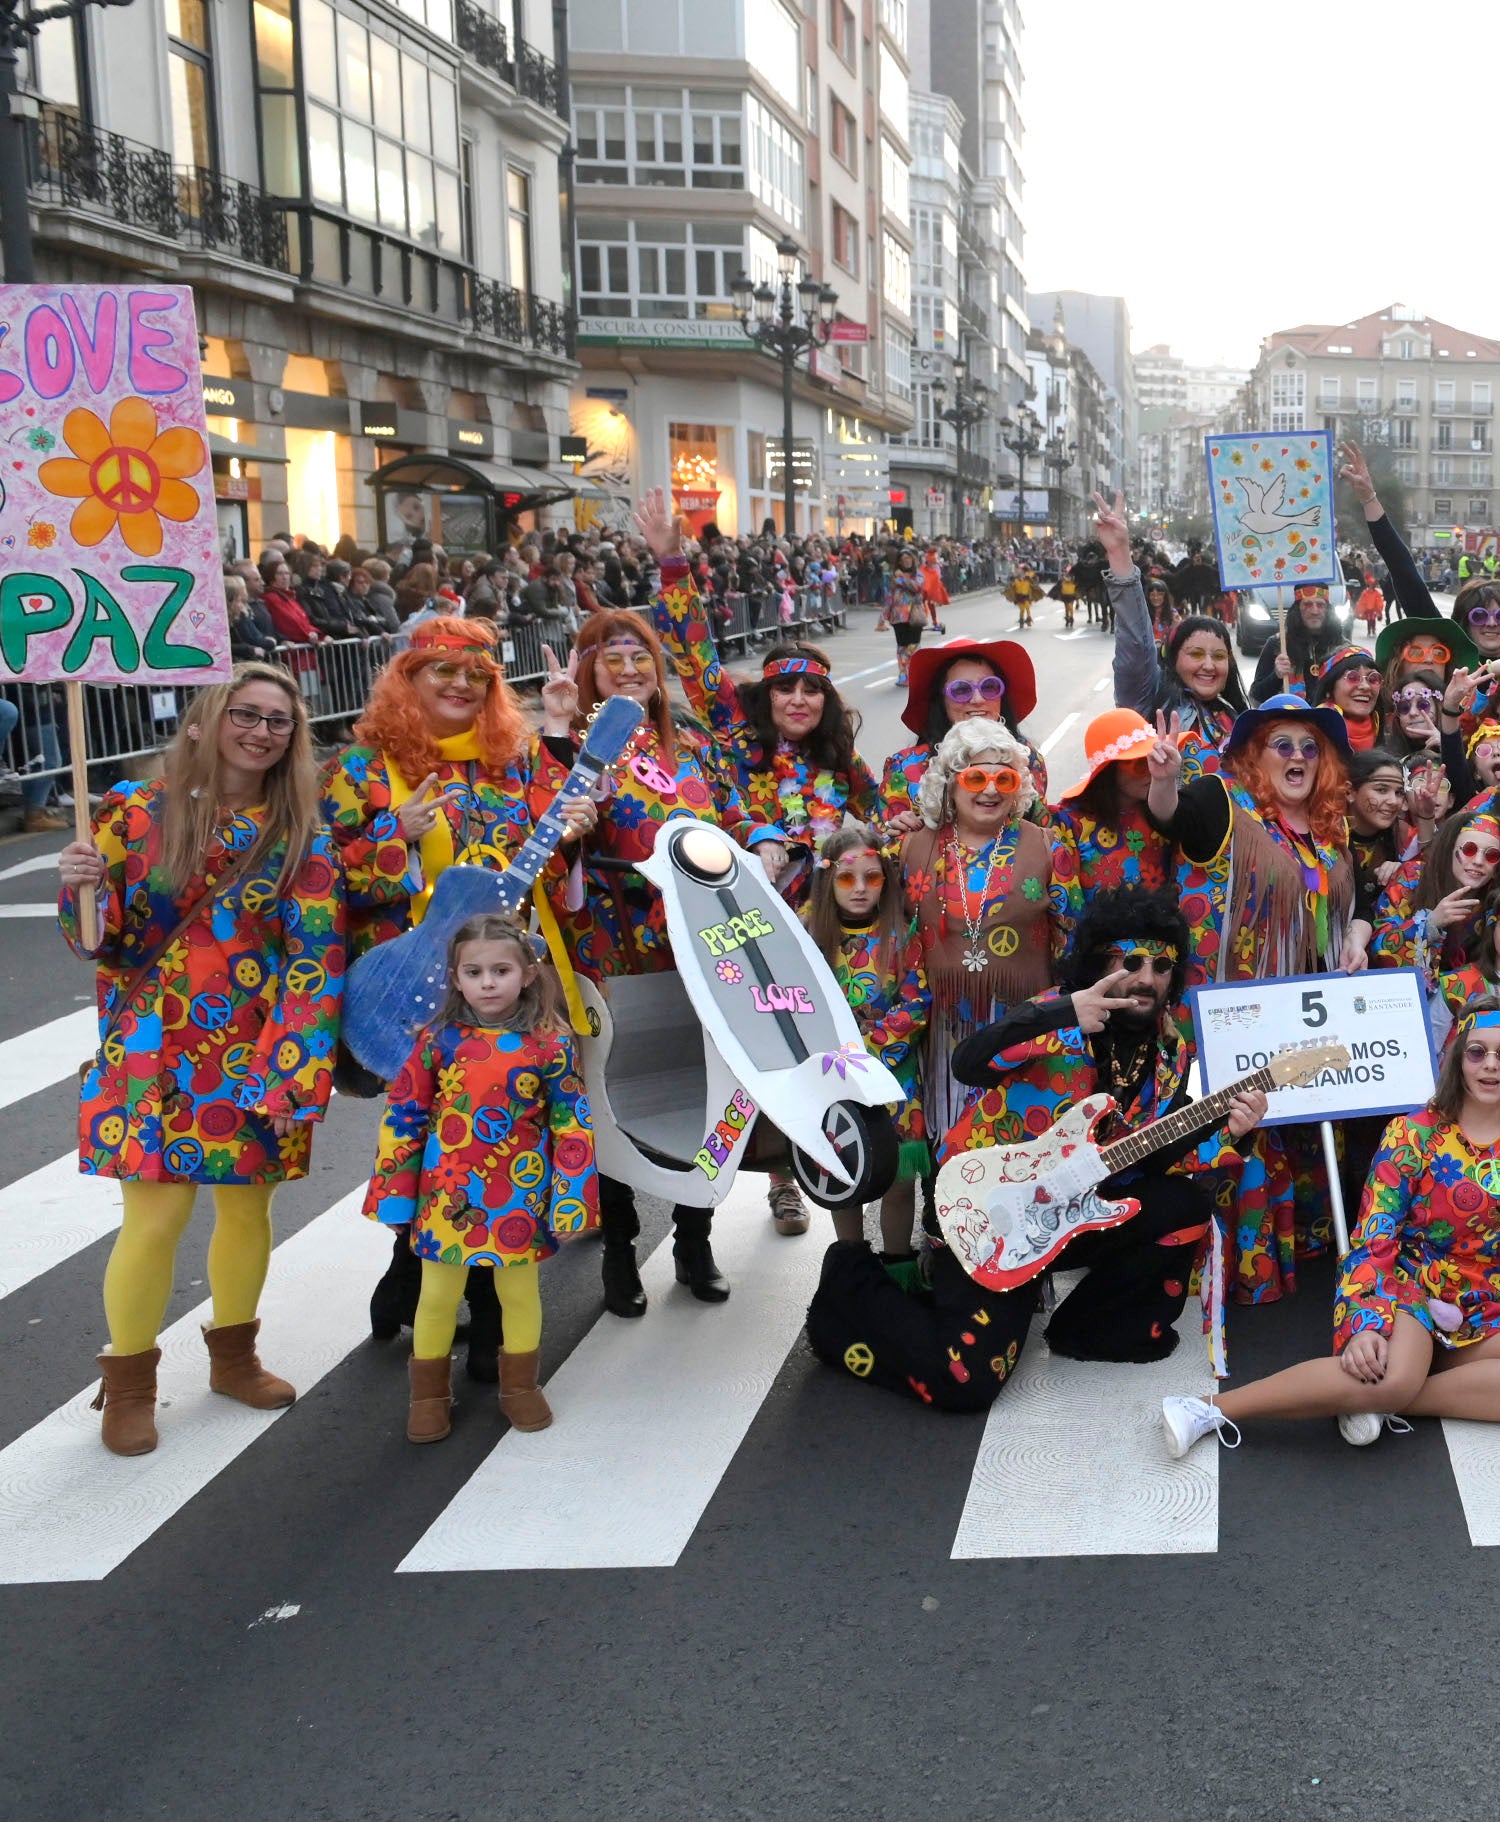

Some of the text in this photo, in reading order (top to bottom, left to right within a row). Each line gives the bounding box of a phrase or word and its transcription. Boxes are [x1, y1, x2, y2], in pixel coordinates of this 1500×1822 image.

[654, 323, 746, 337] CONSULTIN
[203, 387, 235, 406] ANGO
[0, 564, 214, 674] PAZ
[698, 907, 776, 957] PEACE
[749, 983, 816, 1013] LOVE
[1302, 991, 1328, 1027] 5
[692, 1088, 756, 1181] PEACE
